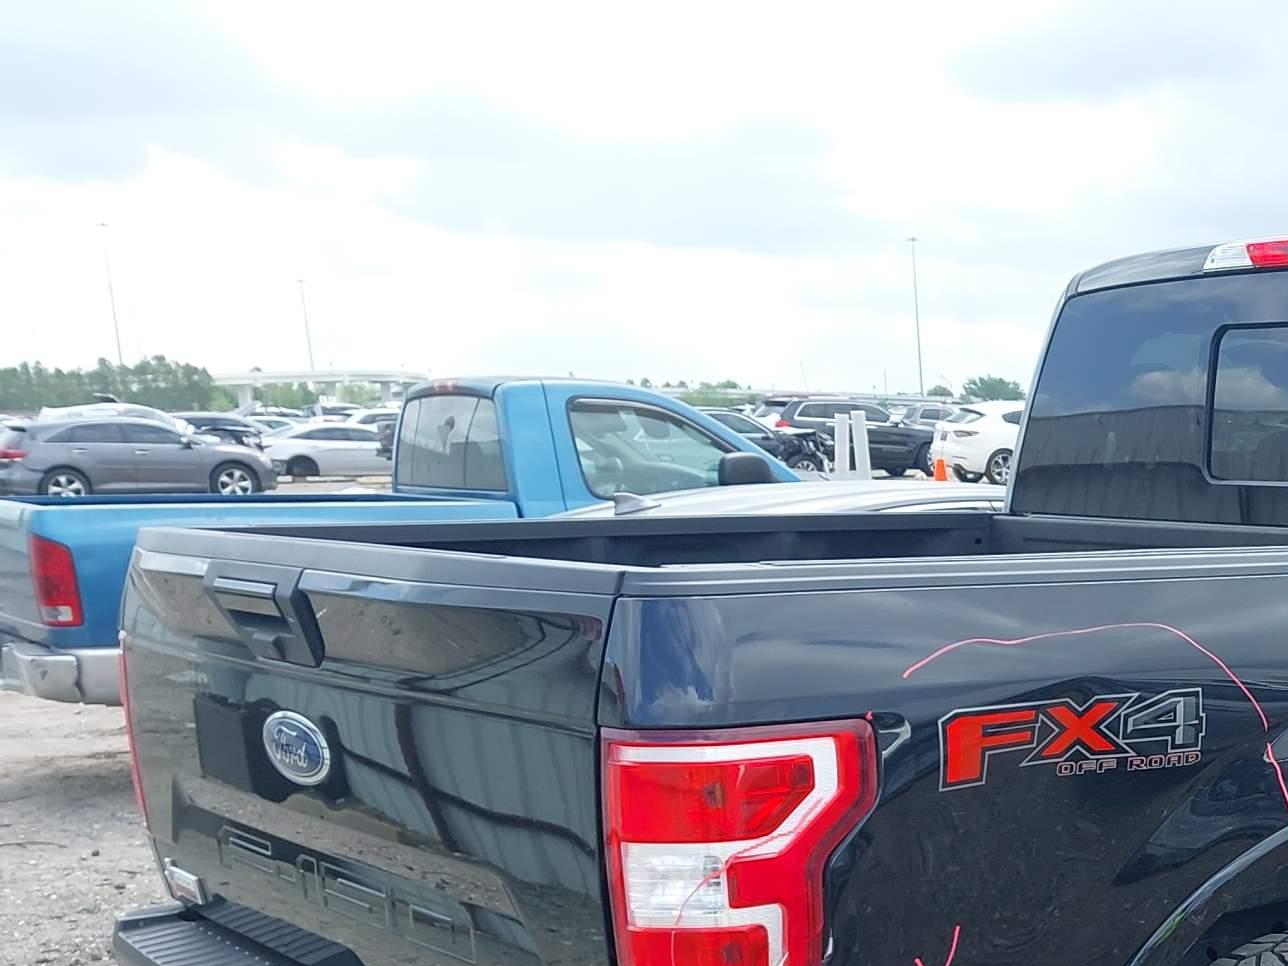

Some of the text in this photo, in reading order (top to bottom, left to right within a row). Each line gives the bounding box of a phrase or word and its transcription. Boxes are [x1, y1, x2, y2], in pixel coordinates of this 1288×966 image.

[272, 724, 308, 768] Ford
[937, 687, 1205, 792] FX4
[1055, 751, 1202, 777] OFF ROAD
